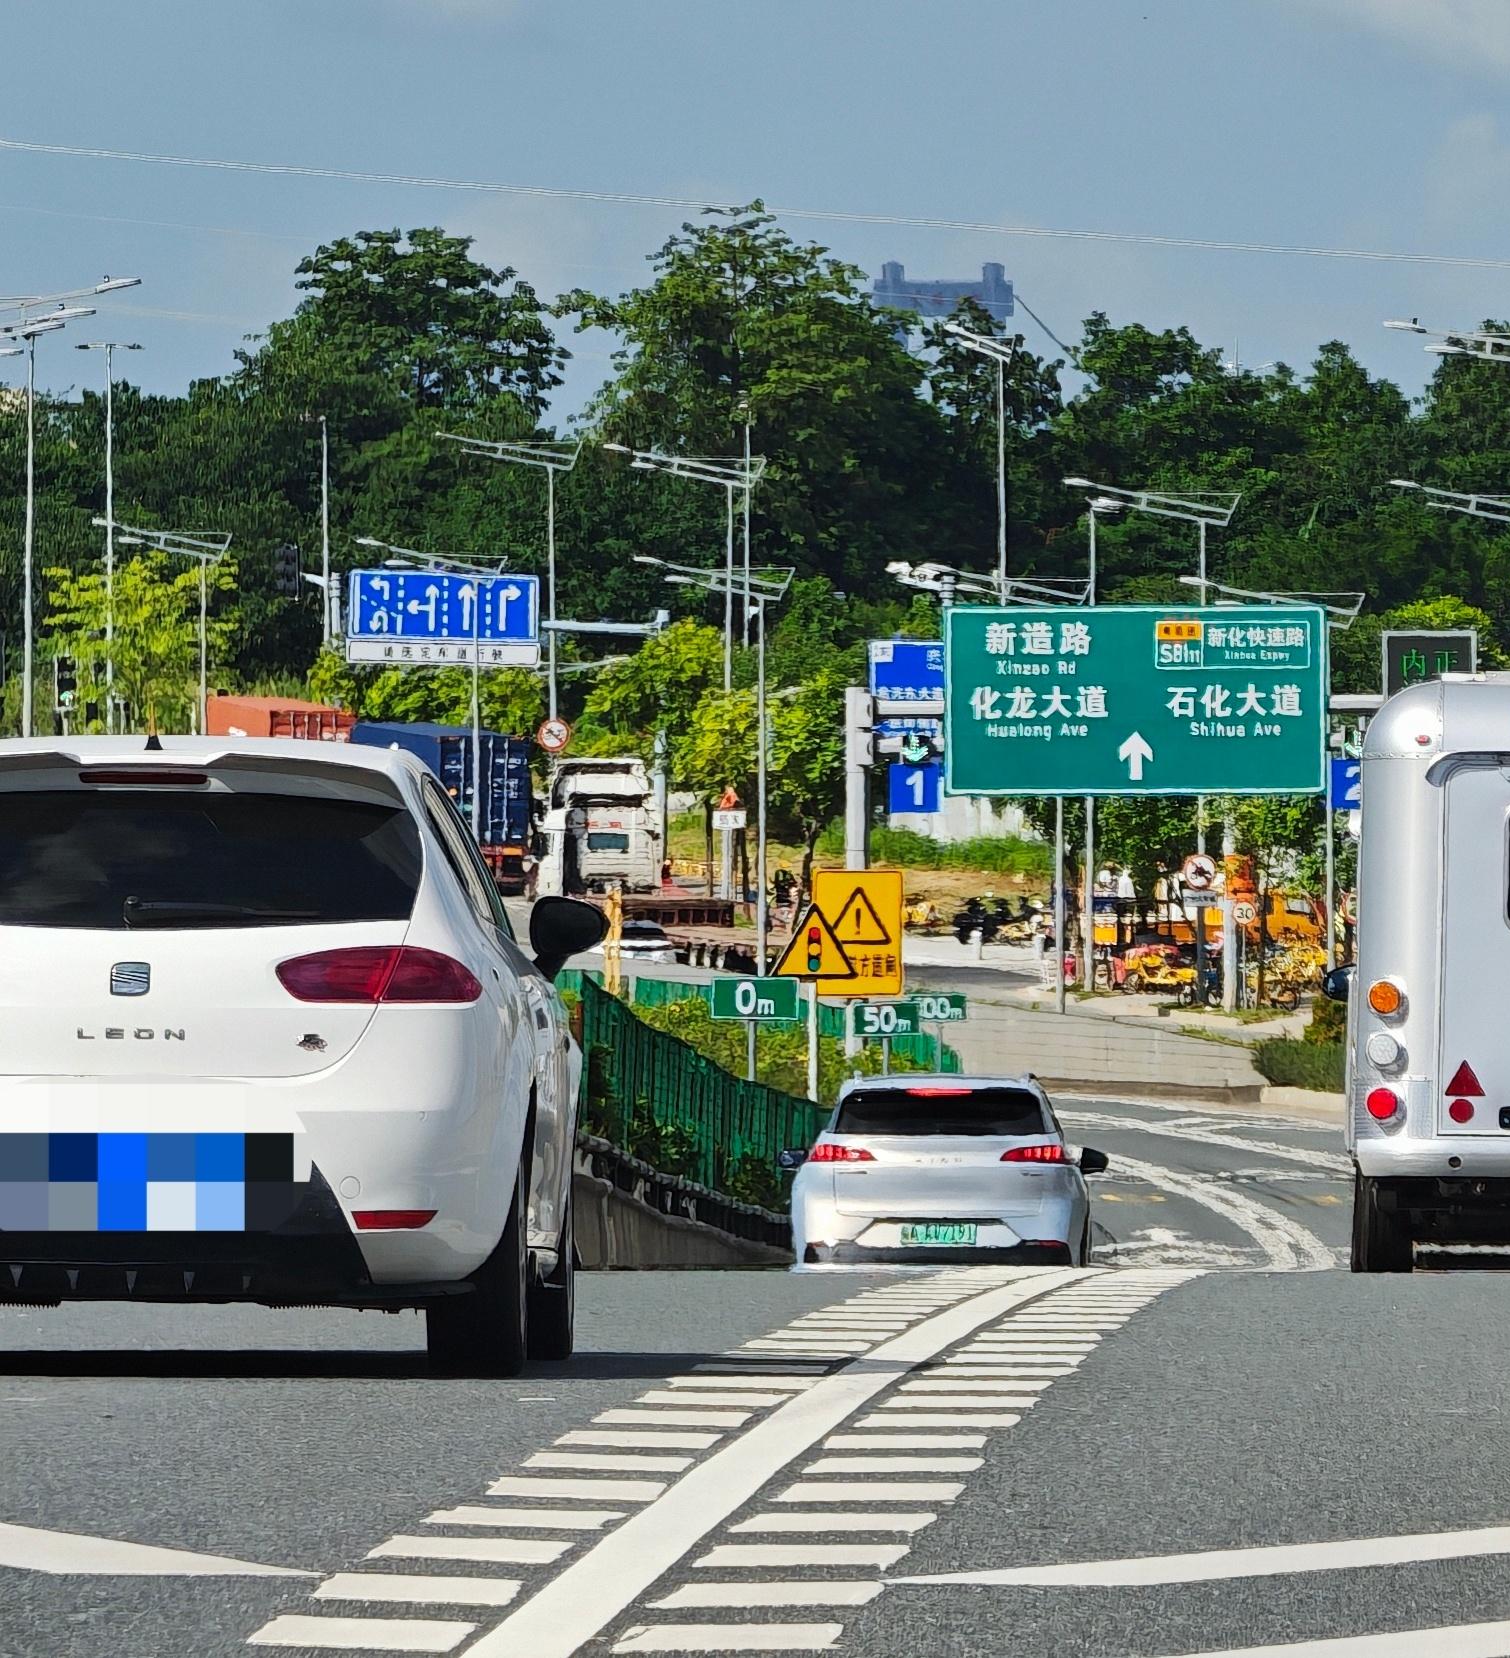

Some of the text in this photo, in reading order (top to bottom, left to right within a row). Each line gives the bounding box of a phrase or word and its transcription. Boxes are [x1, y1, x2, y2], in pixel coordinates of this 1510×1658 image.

[985, 621, 1092, 655] 新造路
[1207, 626, 1305, 647] 新化快速路
[996, 660, 1076, 675] Xinzao Rd
[969, 685, 1109, 720] 化龙大道
[1164, 683, 1303, 718] 石化大道
[986, 723, 1088, 741] Hualong Ave
[1190, 721, 1282, 737] Shihua Ave
[905, 770, 924, 806] 1
[735, 981, 775, 1015] 0m
[918, 995, 964, 1019] 00m
[863, 1005, 912, 1033] 50m
[77, 1027, 186, 1041] LEON
